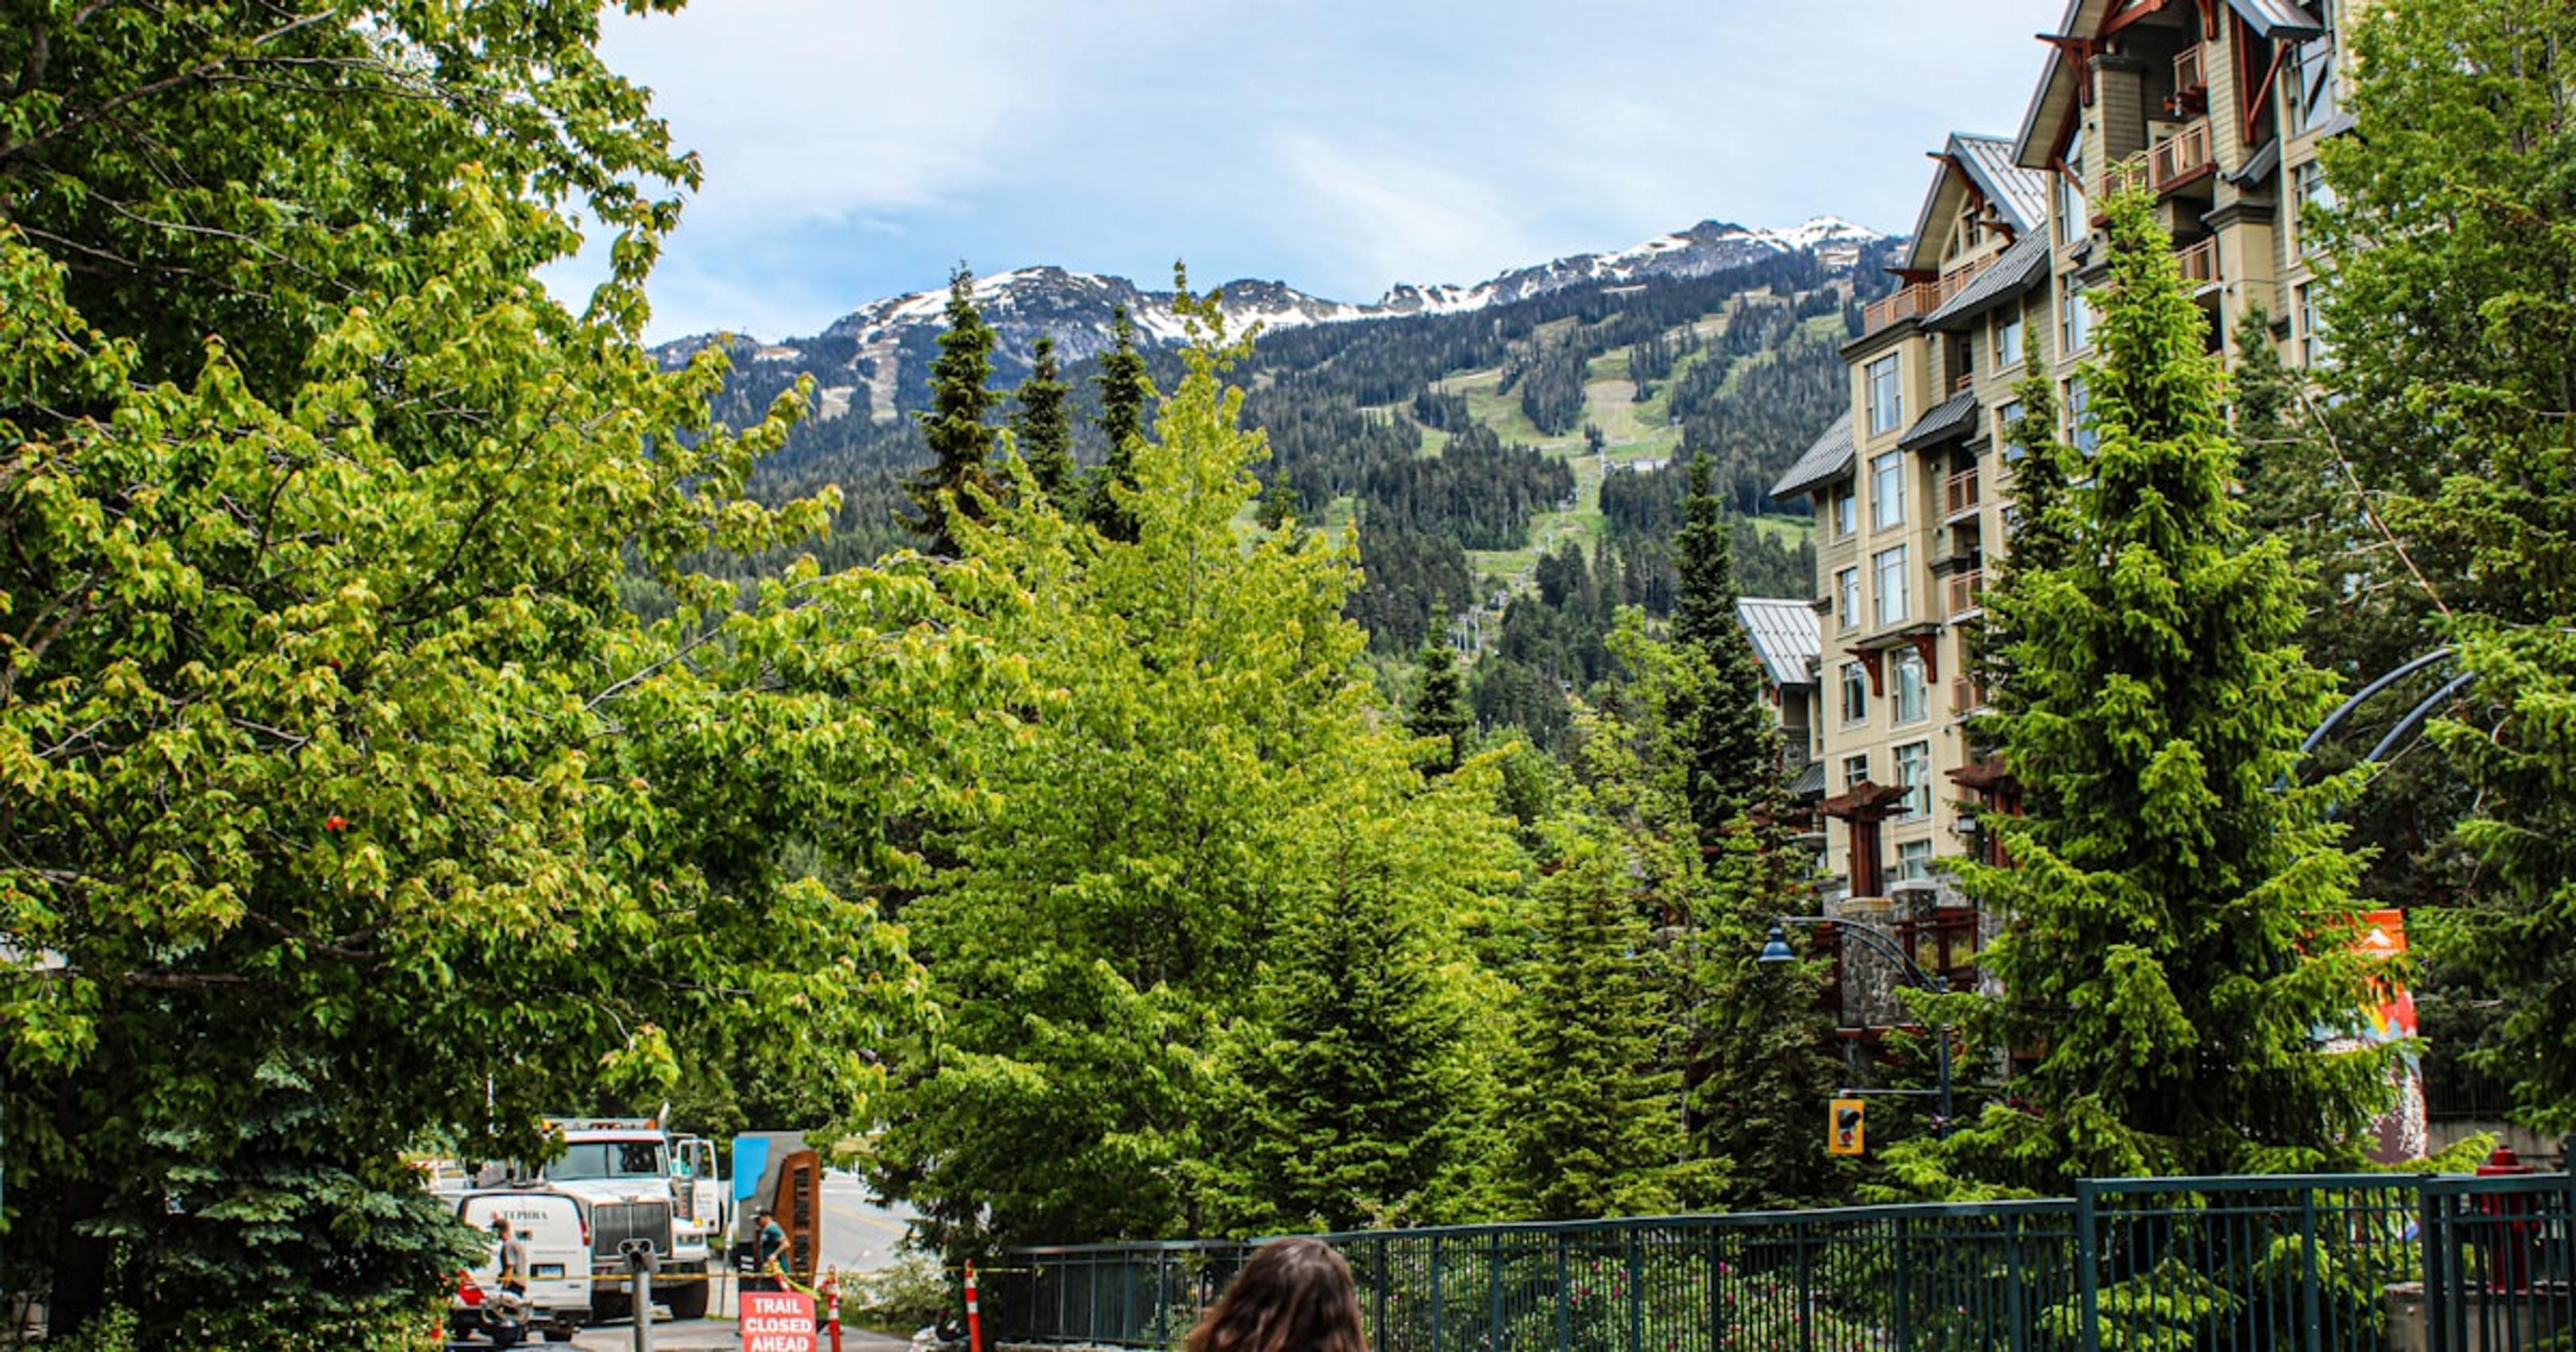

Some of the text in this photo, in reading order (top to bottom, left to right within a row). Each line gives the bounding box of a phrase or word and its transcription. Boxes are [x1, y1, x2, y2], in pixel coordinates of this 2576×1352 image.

[754, 1298, 802, 1314] TRAIL
[745, 1317, 812, 1333] CLOSED
[751, 1336, 809, 1352] AHEAD
